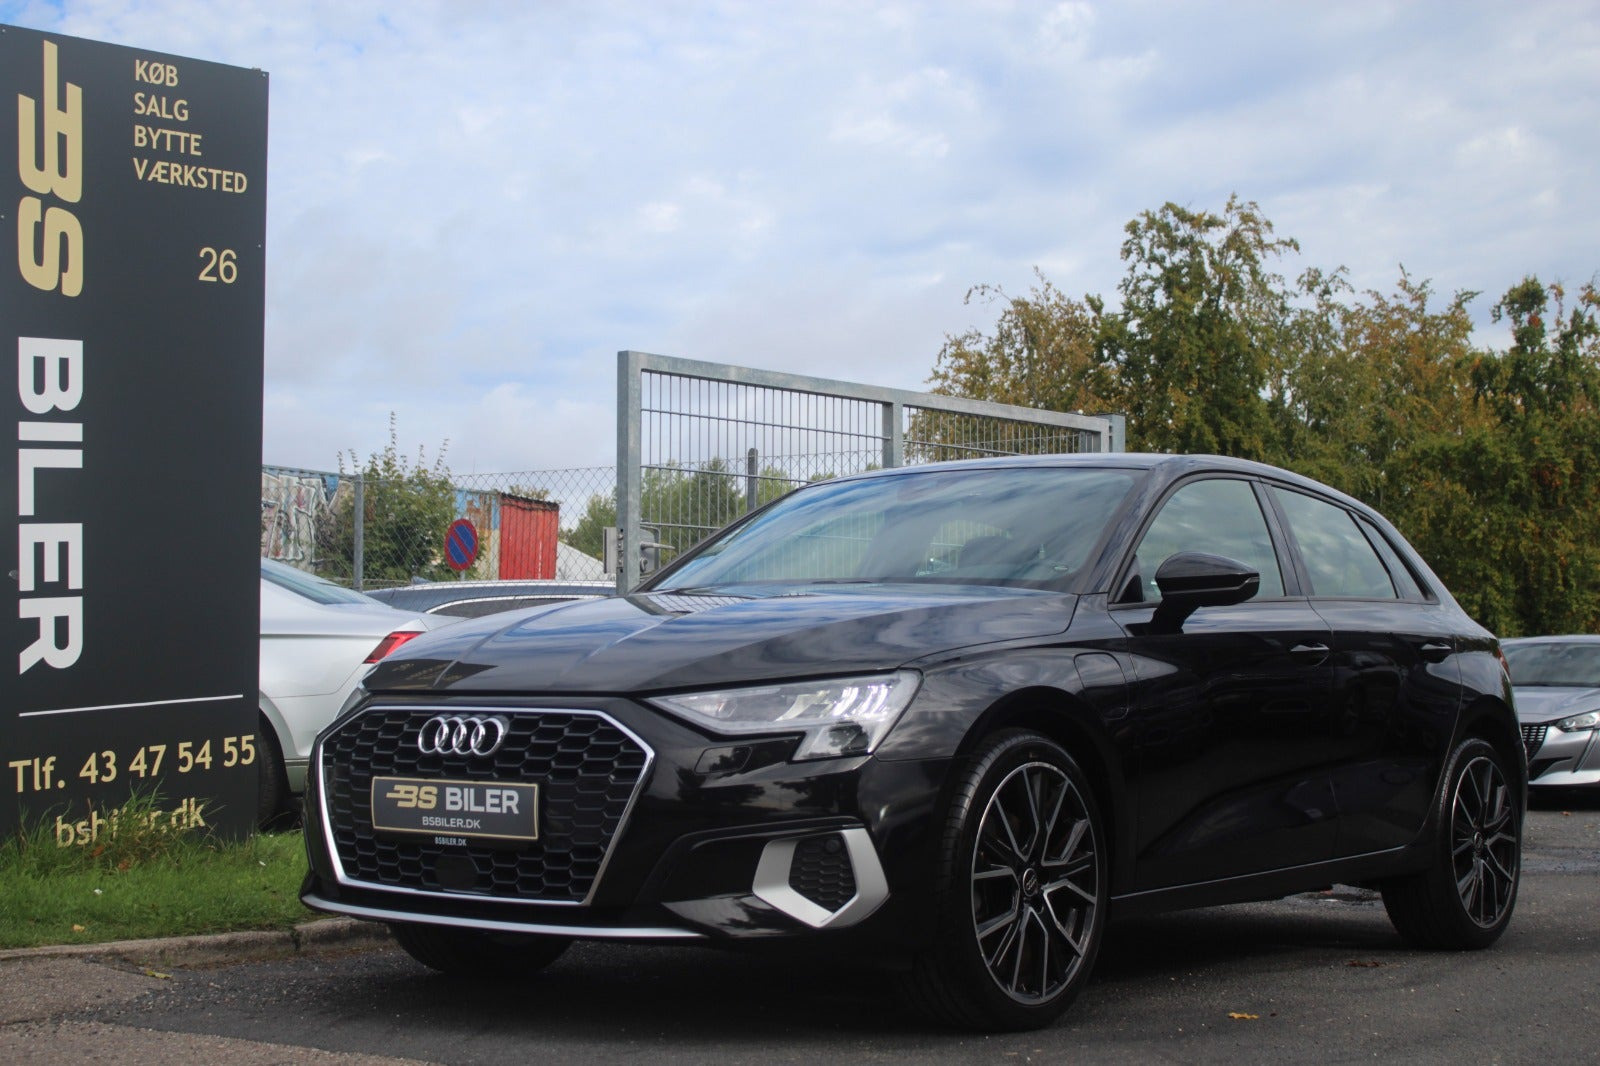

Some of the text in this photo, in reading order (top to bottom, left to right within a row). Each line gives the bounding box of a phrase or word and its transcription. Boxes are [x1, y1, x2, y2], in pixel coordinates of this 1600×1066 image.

[135, 59, 179, 87] KØB
[134, 92, 189, 122] SALG
[134, 124, 202, 156] BYTTE
[133, 157, 248, 194] VÆRKSTED
[198, 247, 238, 284] 26
[18, 336, 83, 675] BILER
[8, 734, 256, 793] Tlf. 43 47 54 55
[386, 784, 519, 814] BS BILER
[422, 816, 481, 829] BSBILER.DK
[435, 836, 467, 847] BSBILER.DK
